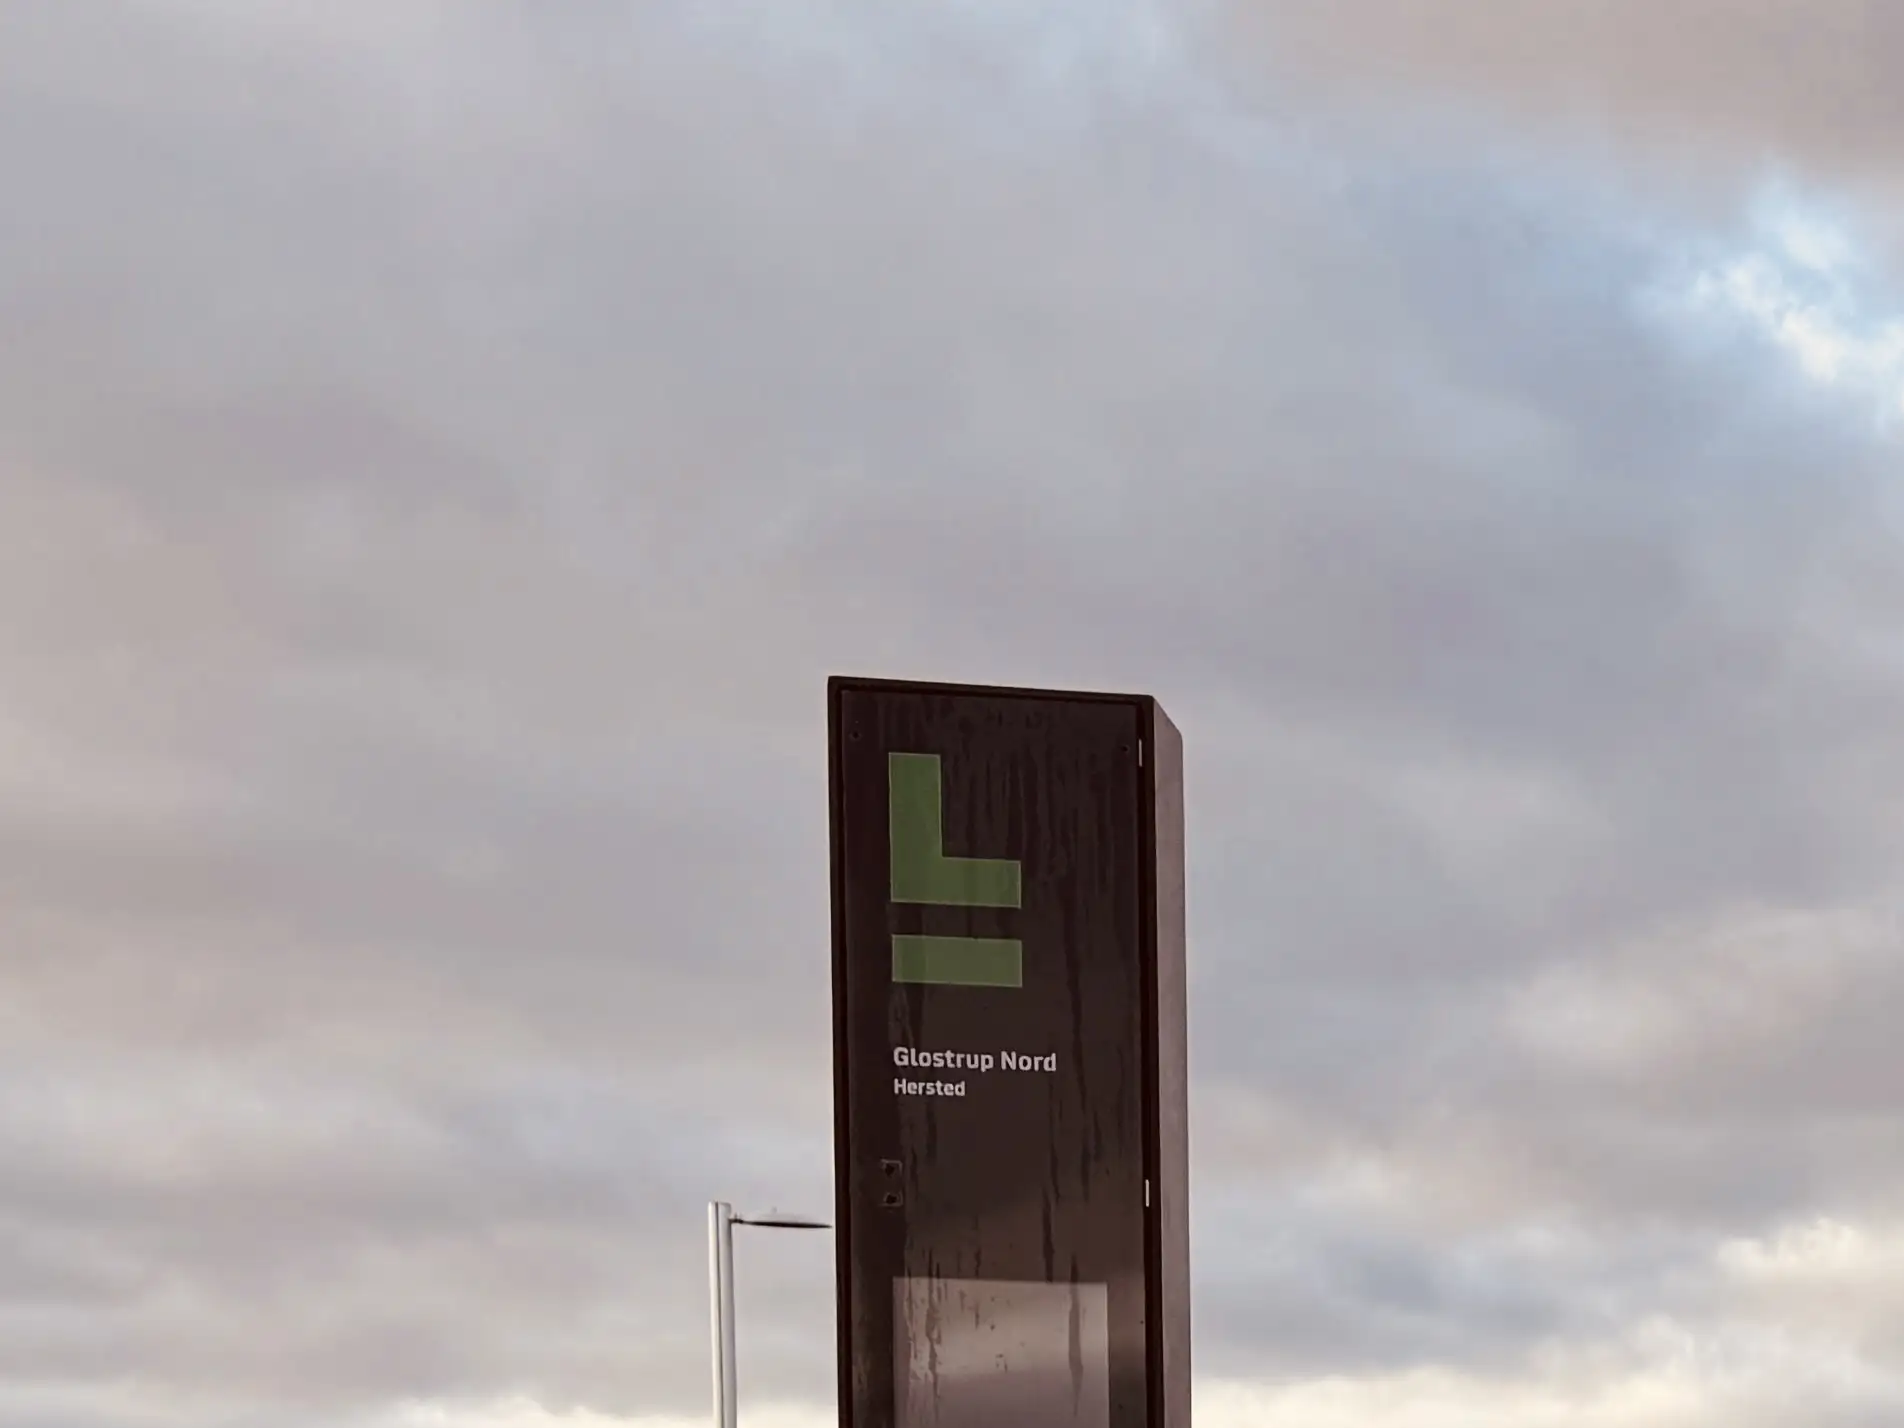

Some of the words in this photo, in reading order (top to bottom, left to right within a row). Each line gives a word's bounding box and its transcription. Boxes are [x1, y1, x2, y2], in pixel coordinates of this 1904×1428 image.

[893, 1047, 994, 1072] Glostrup
[1001, 1051, 1057, 1071] Nord
[894, 1078, 966, 1096] Hersted
